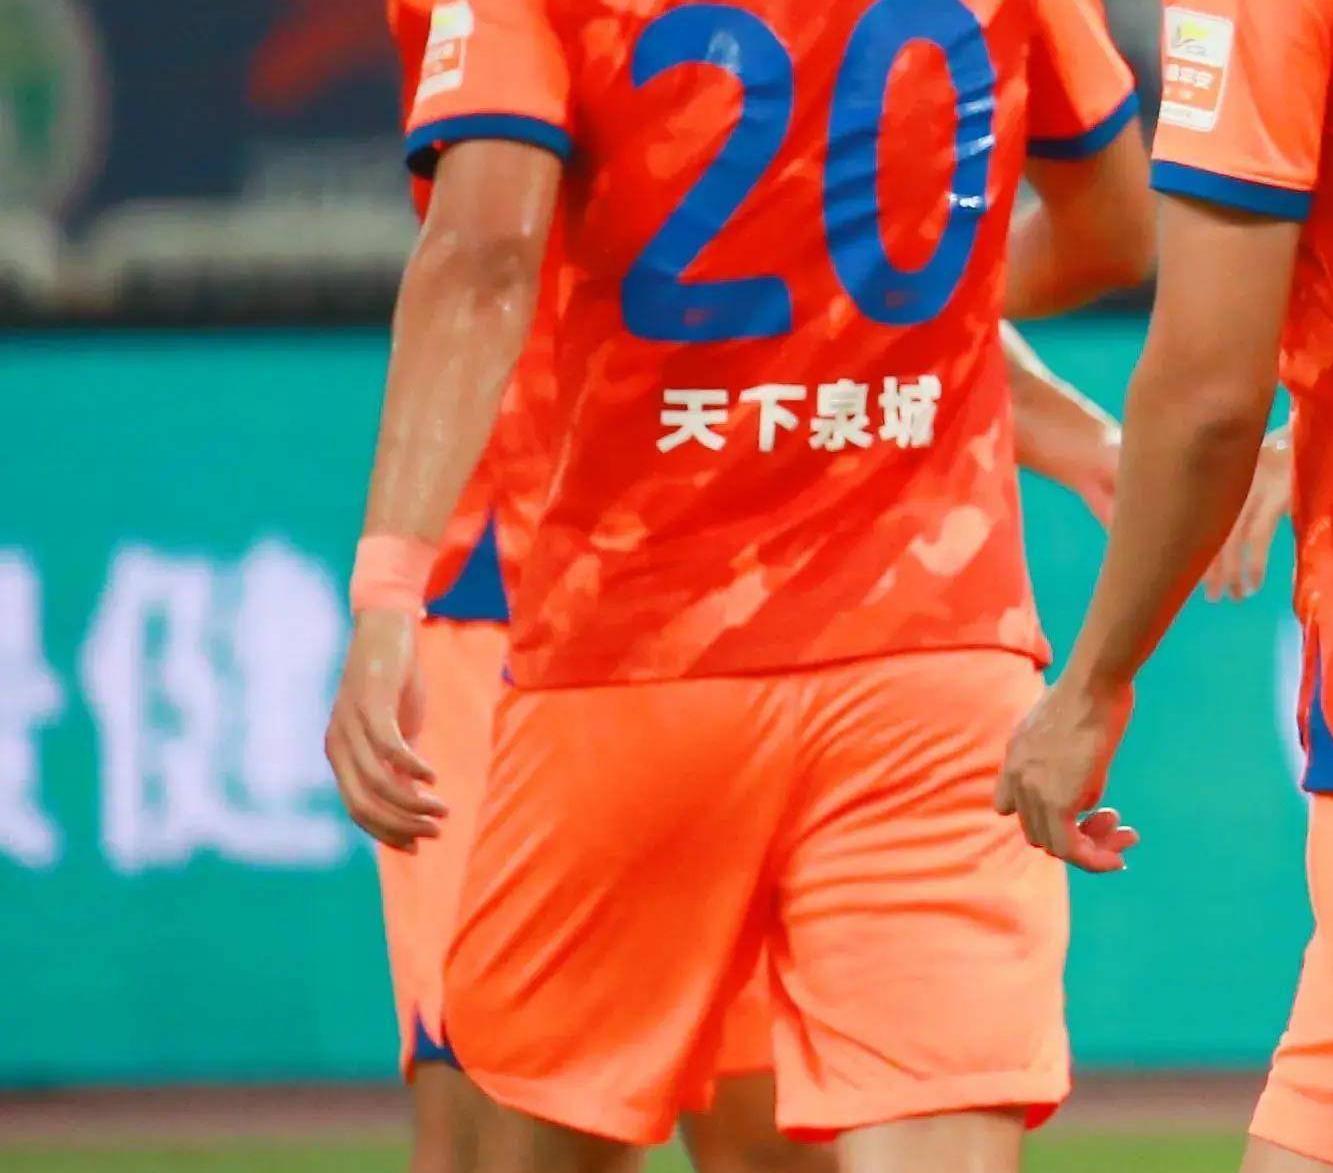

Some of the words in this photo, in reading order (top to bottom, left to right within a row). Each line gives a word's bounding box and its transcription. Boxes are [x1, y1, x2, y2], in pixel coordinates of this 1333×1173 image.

[656, 375, 941, 455] 天下泉城
[0, 534, 352, 872] 健
